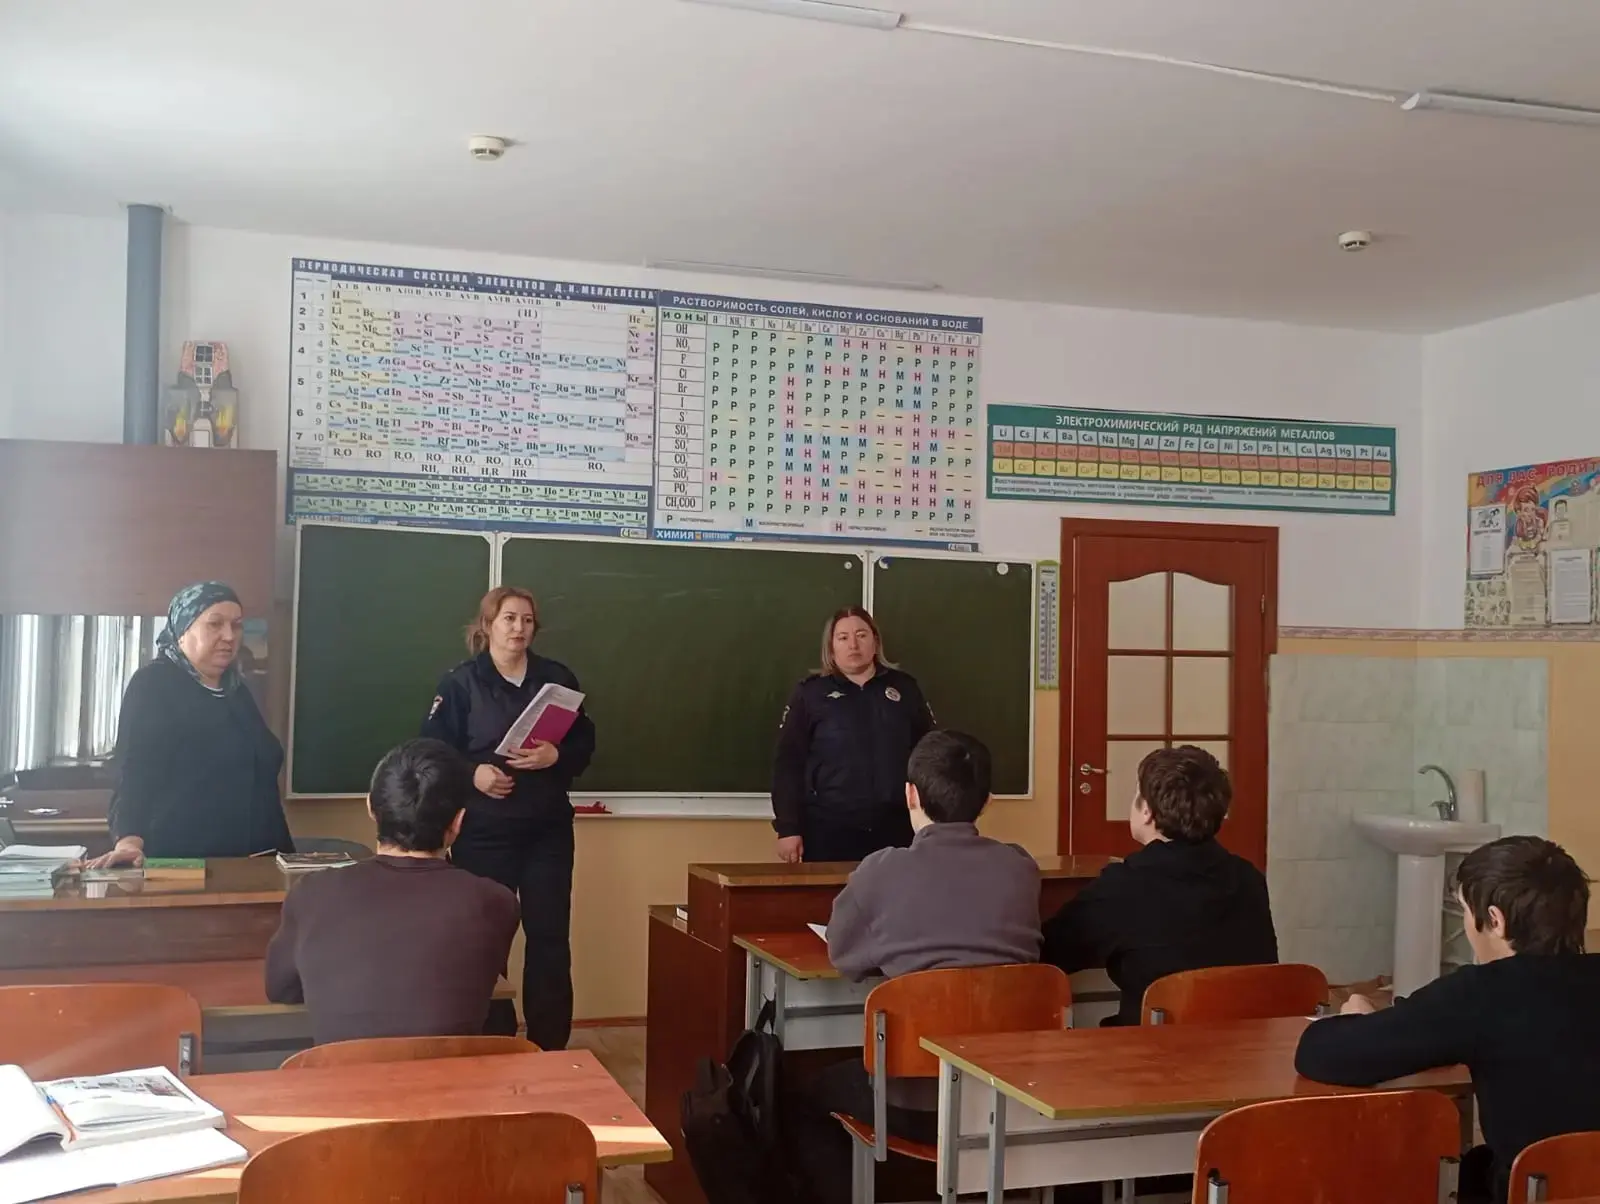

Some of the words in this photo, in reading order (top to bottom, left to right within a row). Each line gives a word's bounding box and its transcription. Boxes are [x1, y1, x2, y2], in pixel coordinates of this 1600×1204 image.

[300, 261, 404, 278] ПЕРИОДИЧЕСКАЯ
[414, 271, 468, 284] СИСТЕМА
[478, 276, 546, 291] ЭЛЕМЕНТОВ
[301, 292, 306, 300] 1
[299, 307, 306, 315] 2
[673, 296, 767, 312] РАСТВОРИМОСТЬ
[770, 305, 809, 316] СОЛЕЙ,
[812, 308, 852, 320] КИСЛОТ
[866, 313, 929, 326] ОСНОВАНИЙ
[942, 320, 969, 329] ВОДЕ
[299, 323, 305, 331] 3
[298, 346, 305, 354] 4
[296, 409, 304, 417] 6
[1056, 415, 1179, 432] ЭЛЕКТРОХИМИЧЕСКИЙ
[1183, 423, 1203, 434] РЯД
[1207, 424, 1276, 438] НАПРЯЖЕНИЙ
[1281, 429, 1335, 440] МЕТАЛЛОВ
[296, 432, 303, 440] 7
[1020, 430, 1029, 438] Cs
[1122, 437, 1134, 446] Mg
[1164, 439, 1174, 447] Zn
[1185, 440, 1194, 448] Fe
[1204, 441, 1214, 449] Co
[1224, 442, 1233, 450] Ni
[1243, 443, 1253, 451] Sn
[1320, 447, 1332, 455] Ag
[1376, 450, 1387, 458] Au
[656, 530, 694, 540] ХИМИЯ
